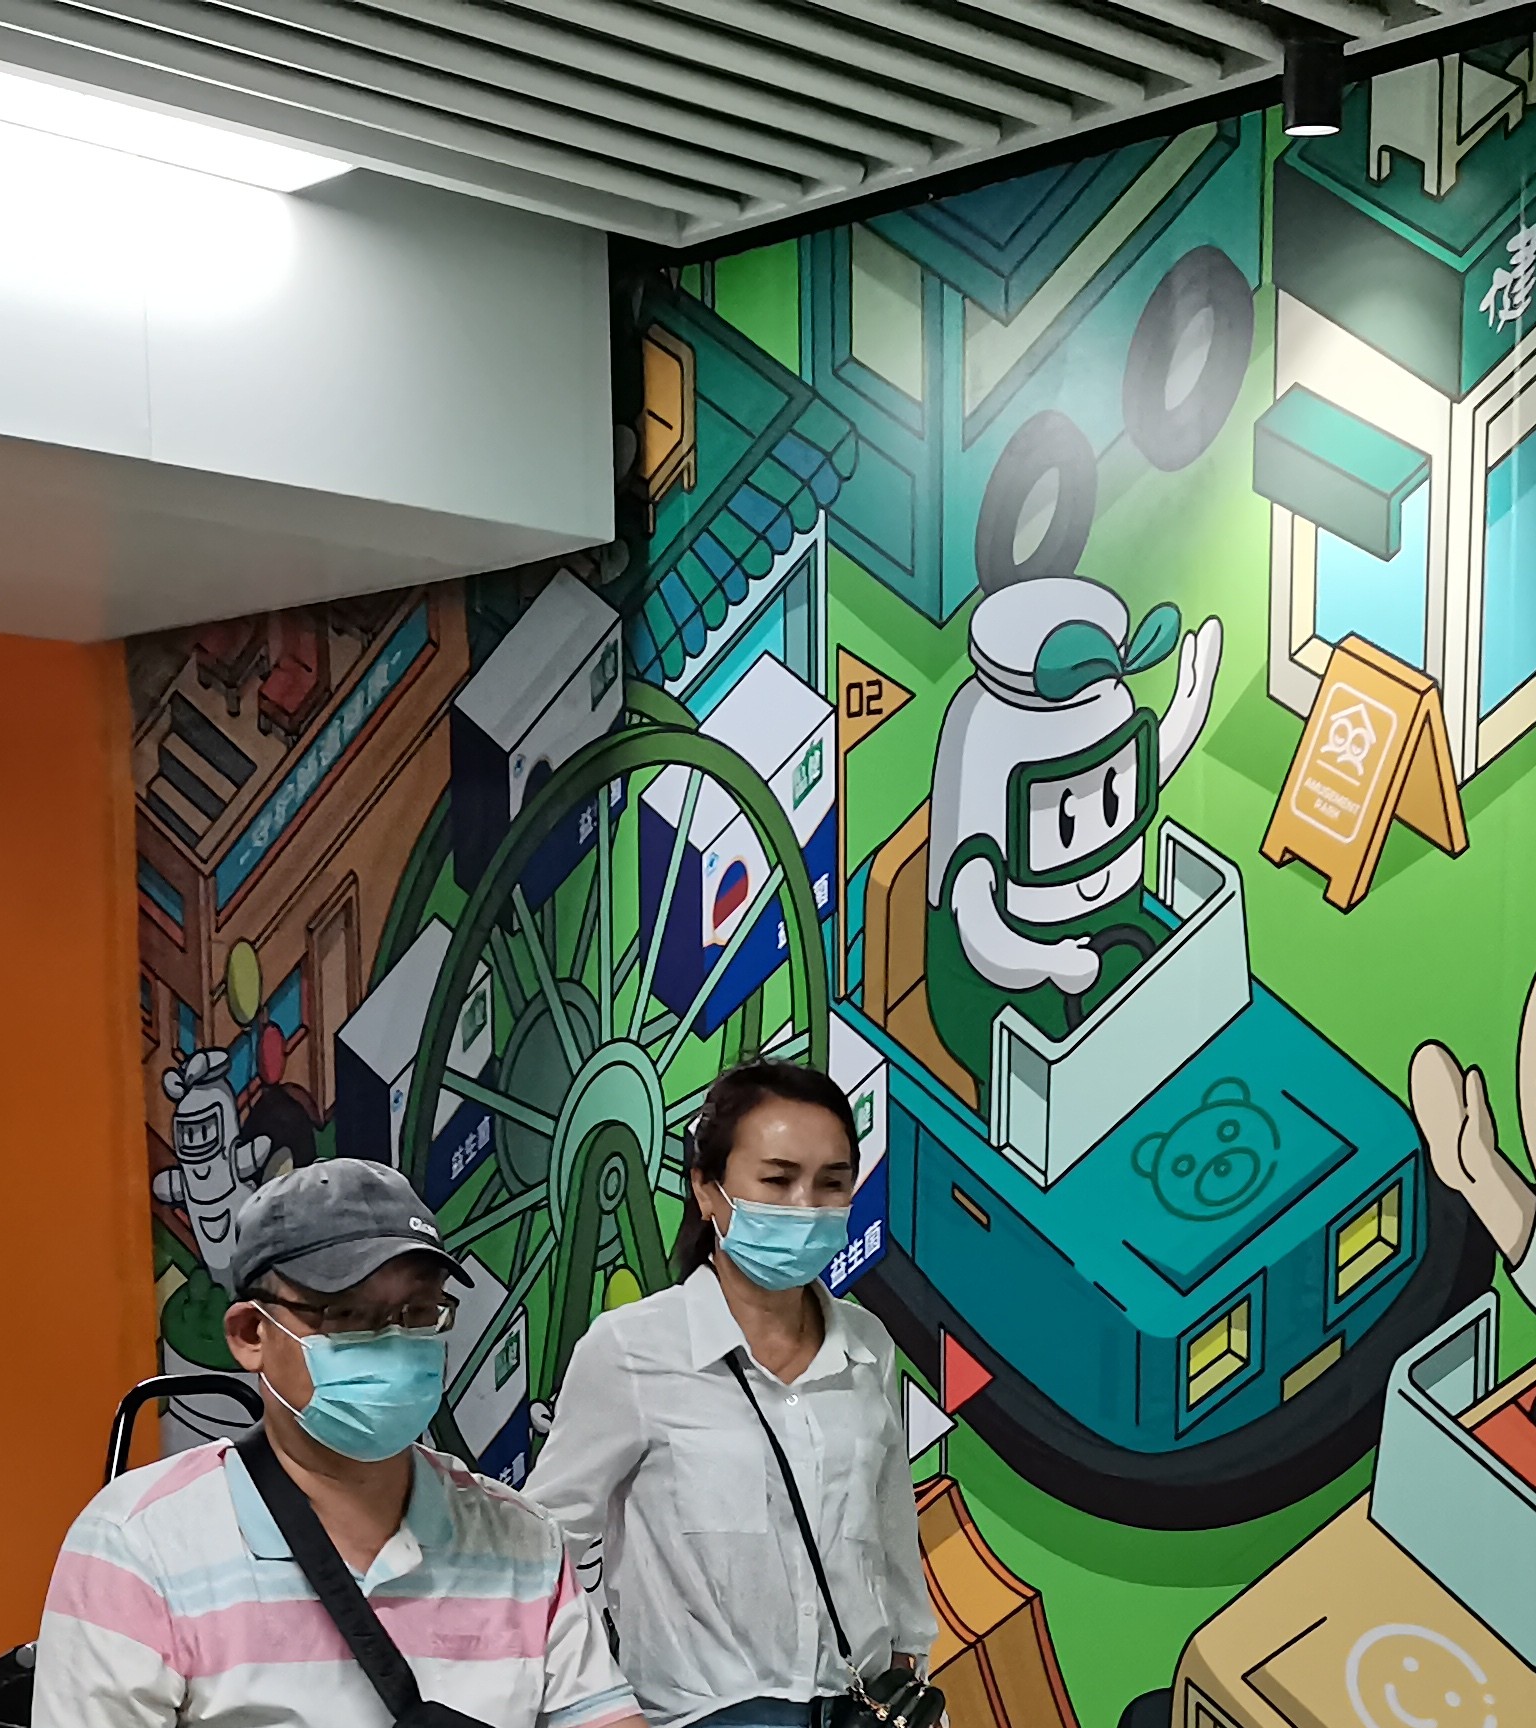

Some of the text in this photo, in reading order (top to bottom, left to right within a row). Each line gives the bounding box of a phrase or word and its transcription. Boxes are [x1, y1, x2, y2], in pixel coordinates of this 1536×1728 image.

[846, 679, 883, 718] 02
[829, 1219, 882, 1291] 益生菌
